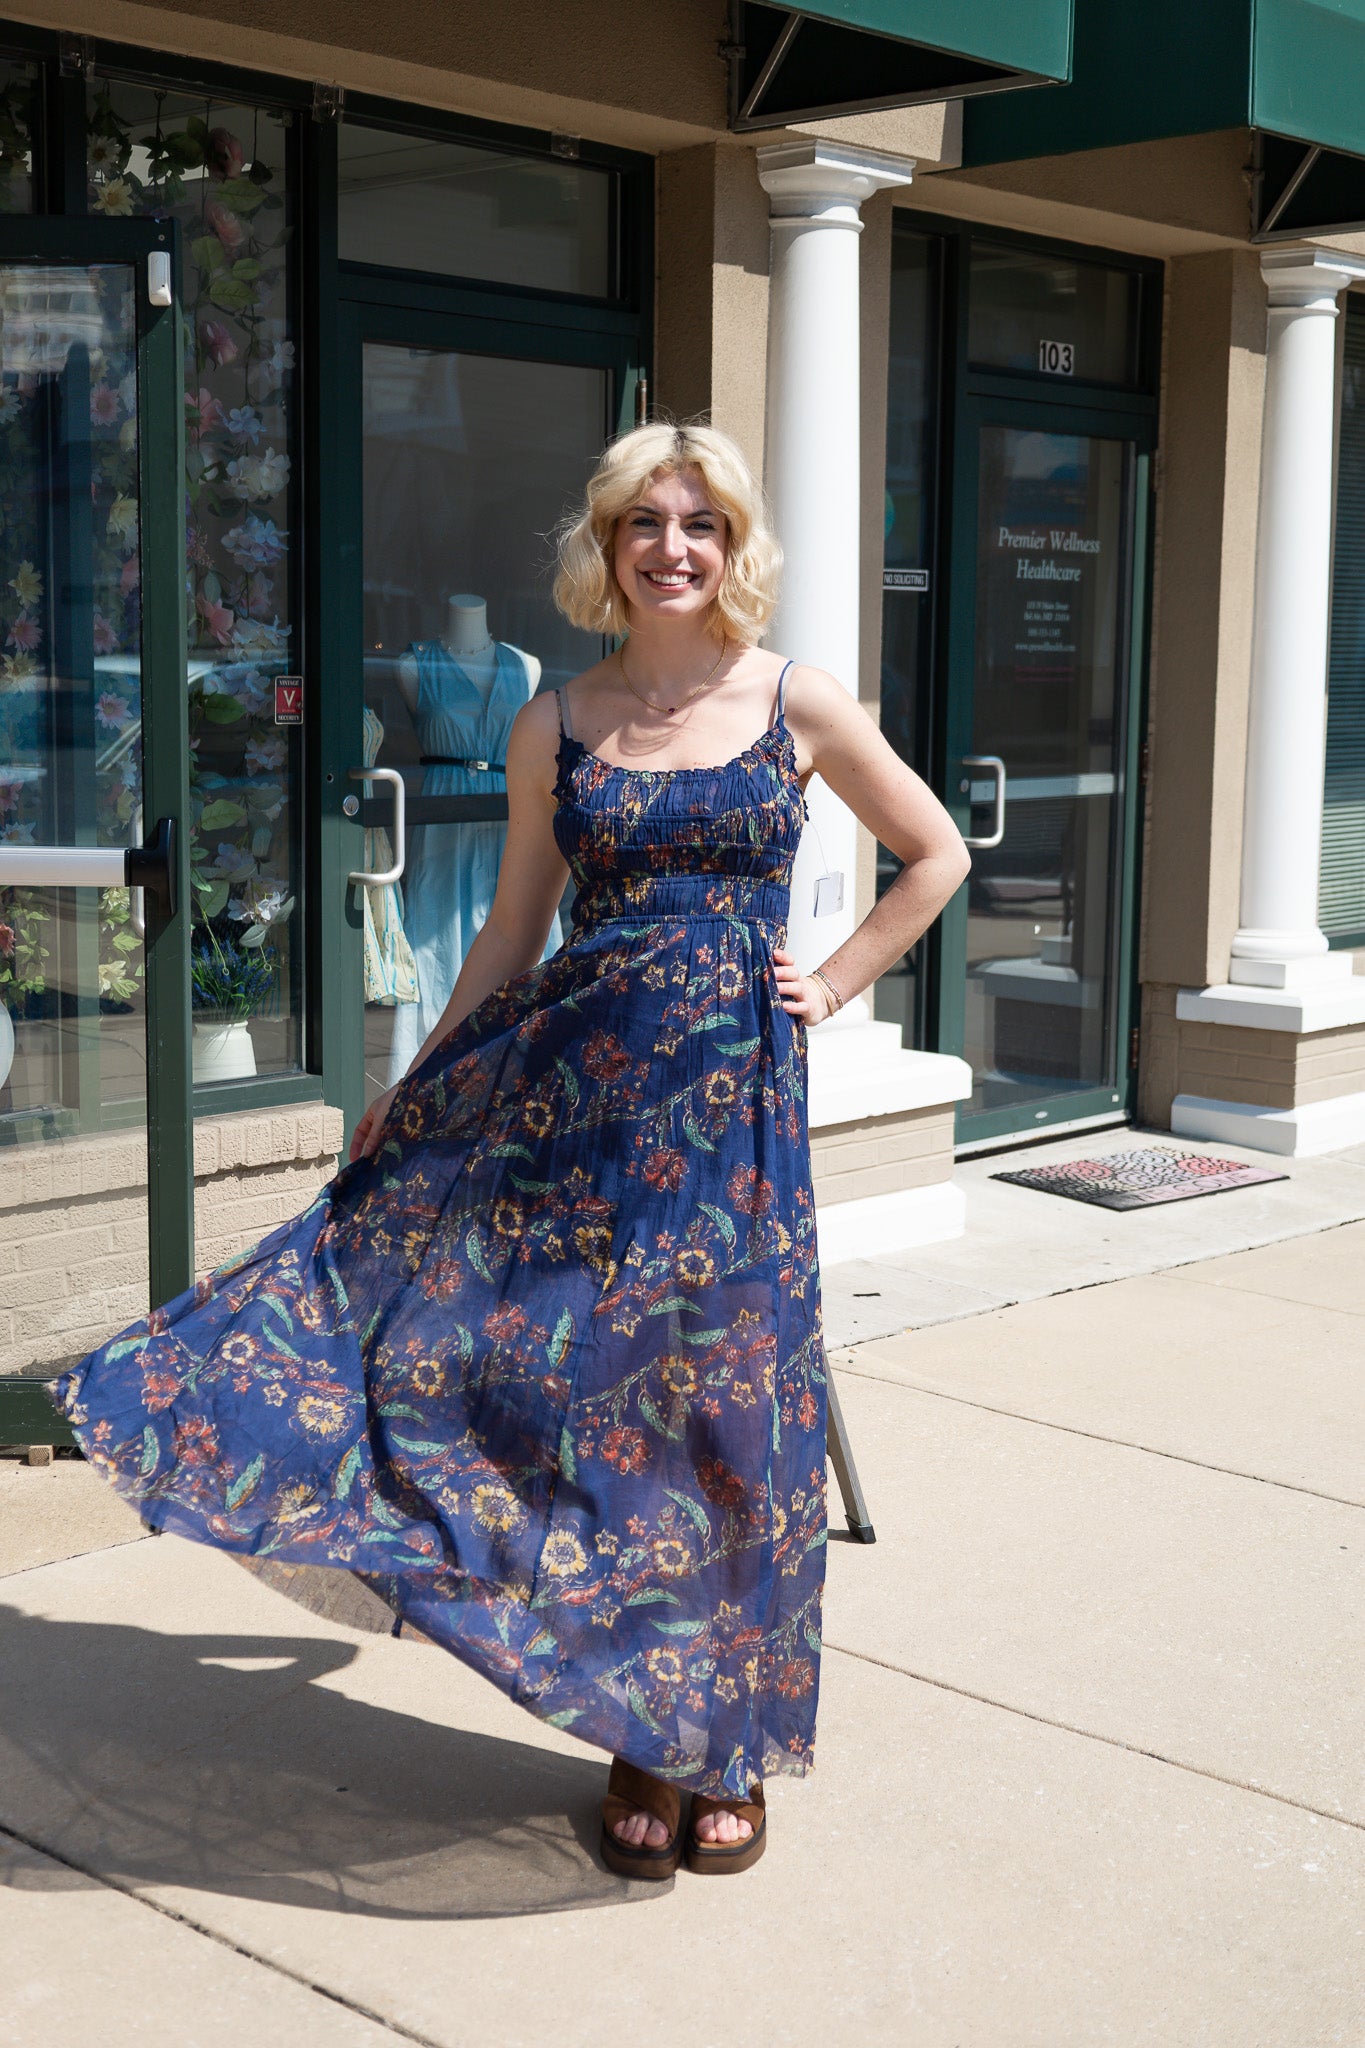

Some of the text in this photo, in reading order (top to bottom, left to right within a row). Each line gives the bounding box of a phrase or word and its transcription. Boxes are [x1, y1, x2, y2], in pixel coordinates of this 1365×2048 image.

[1041, 341, 1071, 373] 103
[998, 526, 1101, 553] Premier Wellness
[884, 573, 924, 586] NO SOLICITING
[1016, 558, 1081, 581] Healthcare
[283, 690, 296, 708] V
